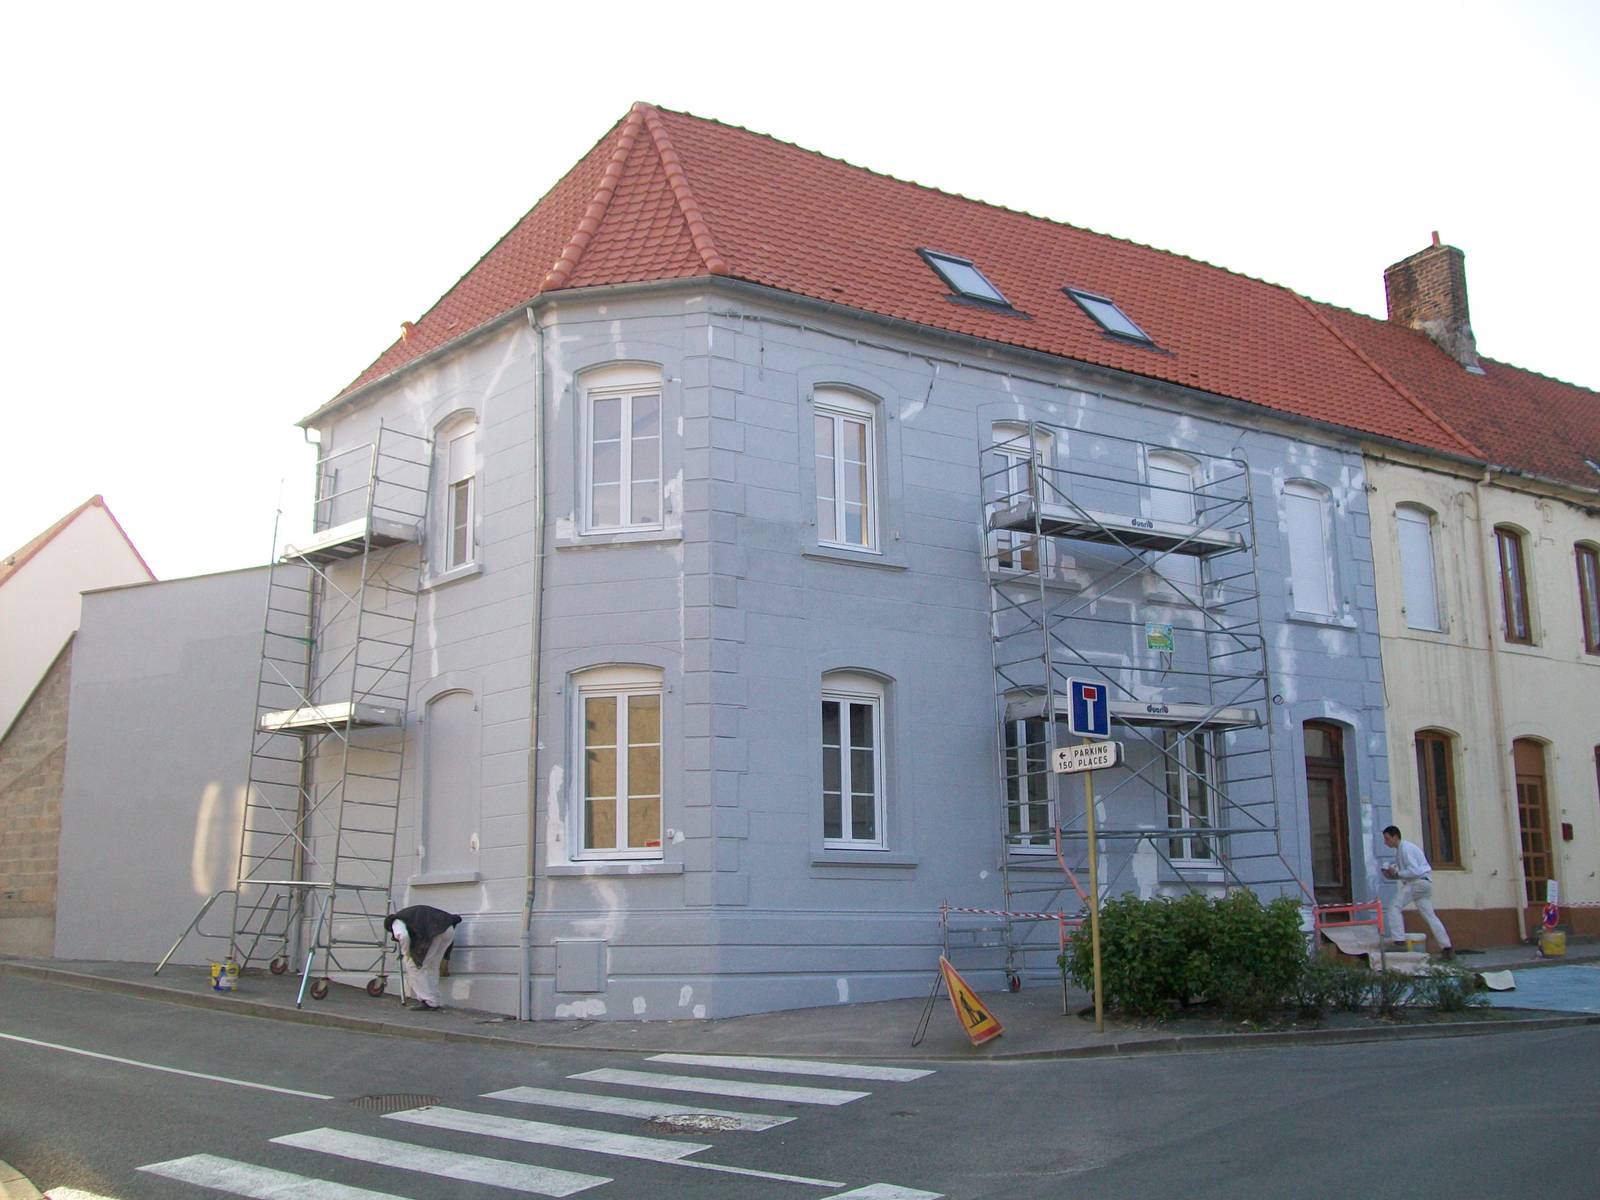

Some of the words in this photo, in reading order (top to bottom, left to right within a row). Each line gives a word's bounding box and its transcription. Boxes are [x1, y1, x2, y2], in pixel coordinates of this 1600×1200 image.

[1074, 745, 1108, 758] PARKING
[1059, 760, 1073, 770] 150
[1078, 755, 1108, 767] PLACES
